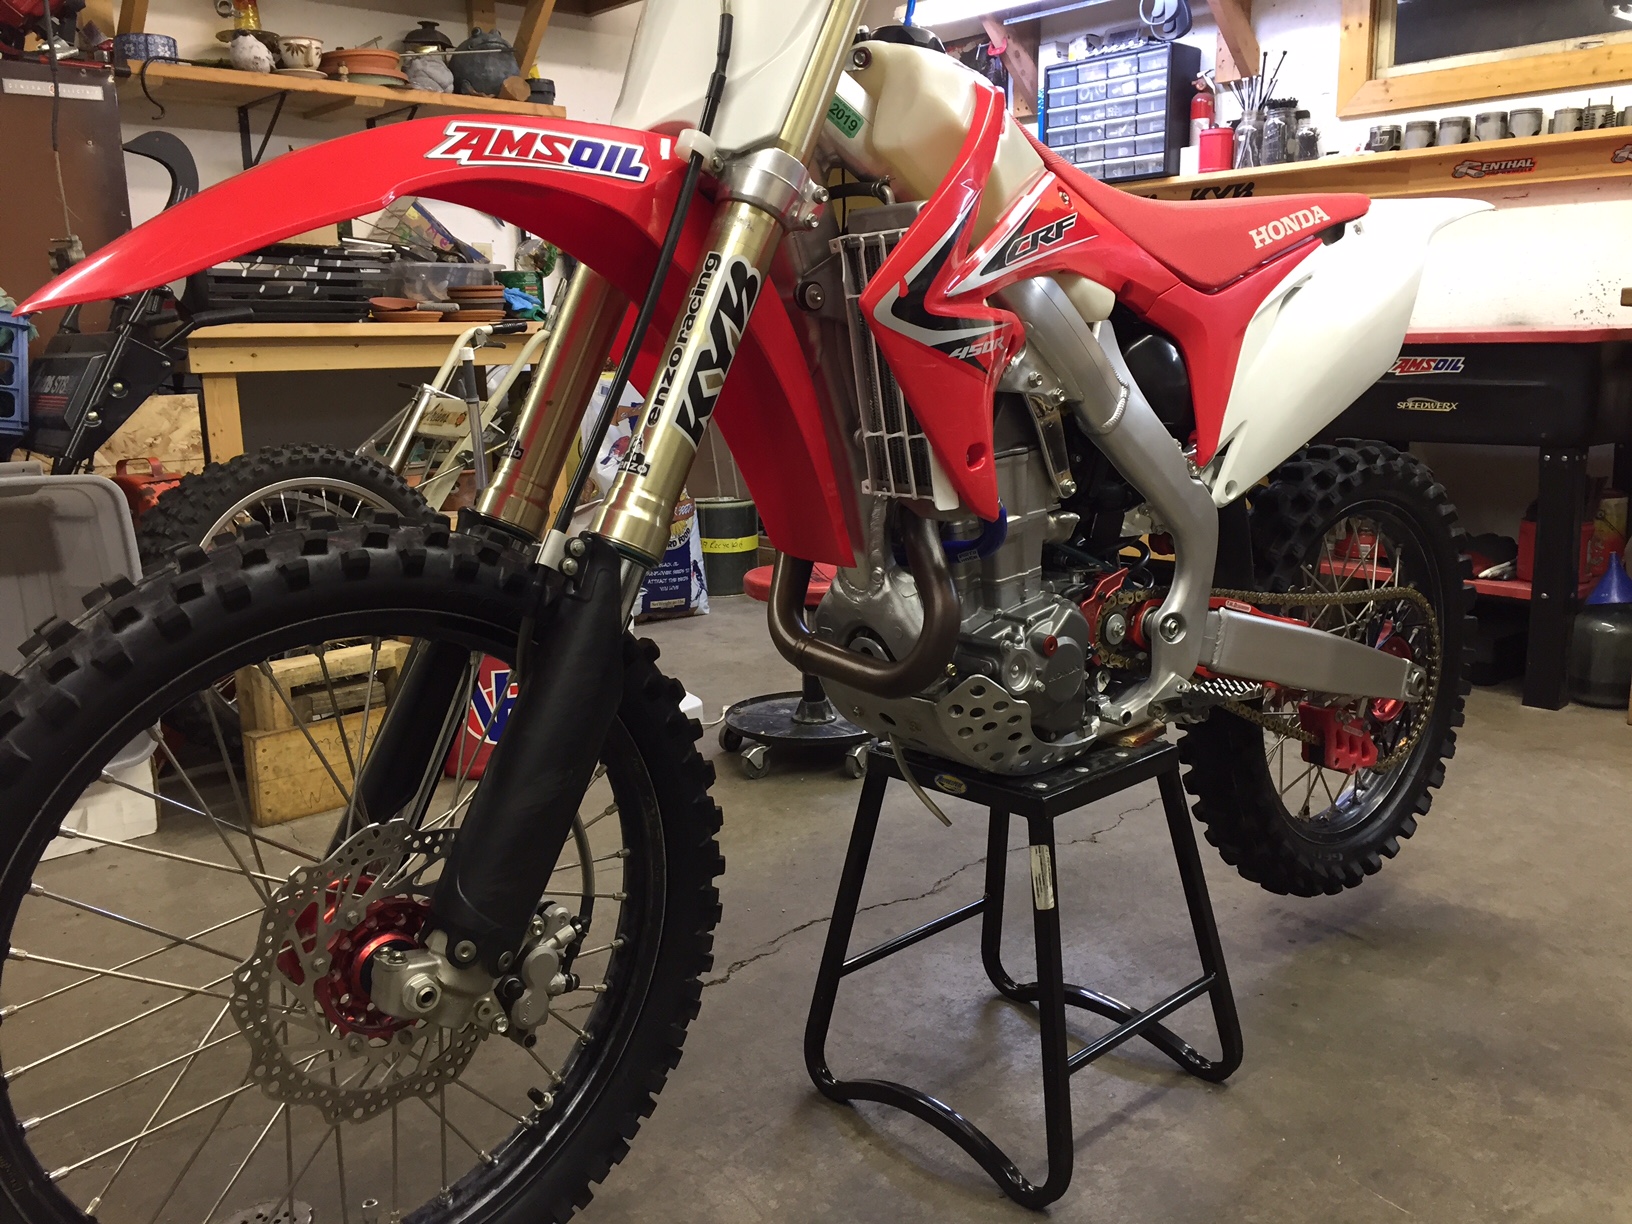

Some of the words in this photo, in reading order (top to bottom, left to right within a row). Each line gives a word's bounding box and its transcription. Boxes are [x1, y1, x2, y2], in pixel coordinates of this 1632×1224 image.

[829, 102, 858, 131] 2019
[438, 125, 646, 179] AMSOIL
[1190, 181, 1255, 200] KYB
[1005, 212, 1078, 266] CRF
[1249, 205, 1330, 249] HONDA
[675, 260, 759, 448] KYB
[948, 336, 1005, 359] 450R
[1390, 357, 1464, 374] AMSOIL
[1397, 401, 1458, 411] SPEEDWERX
